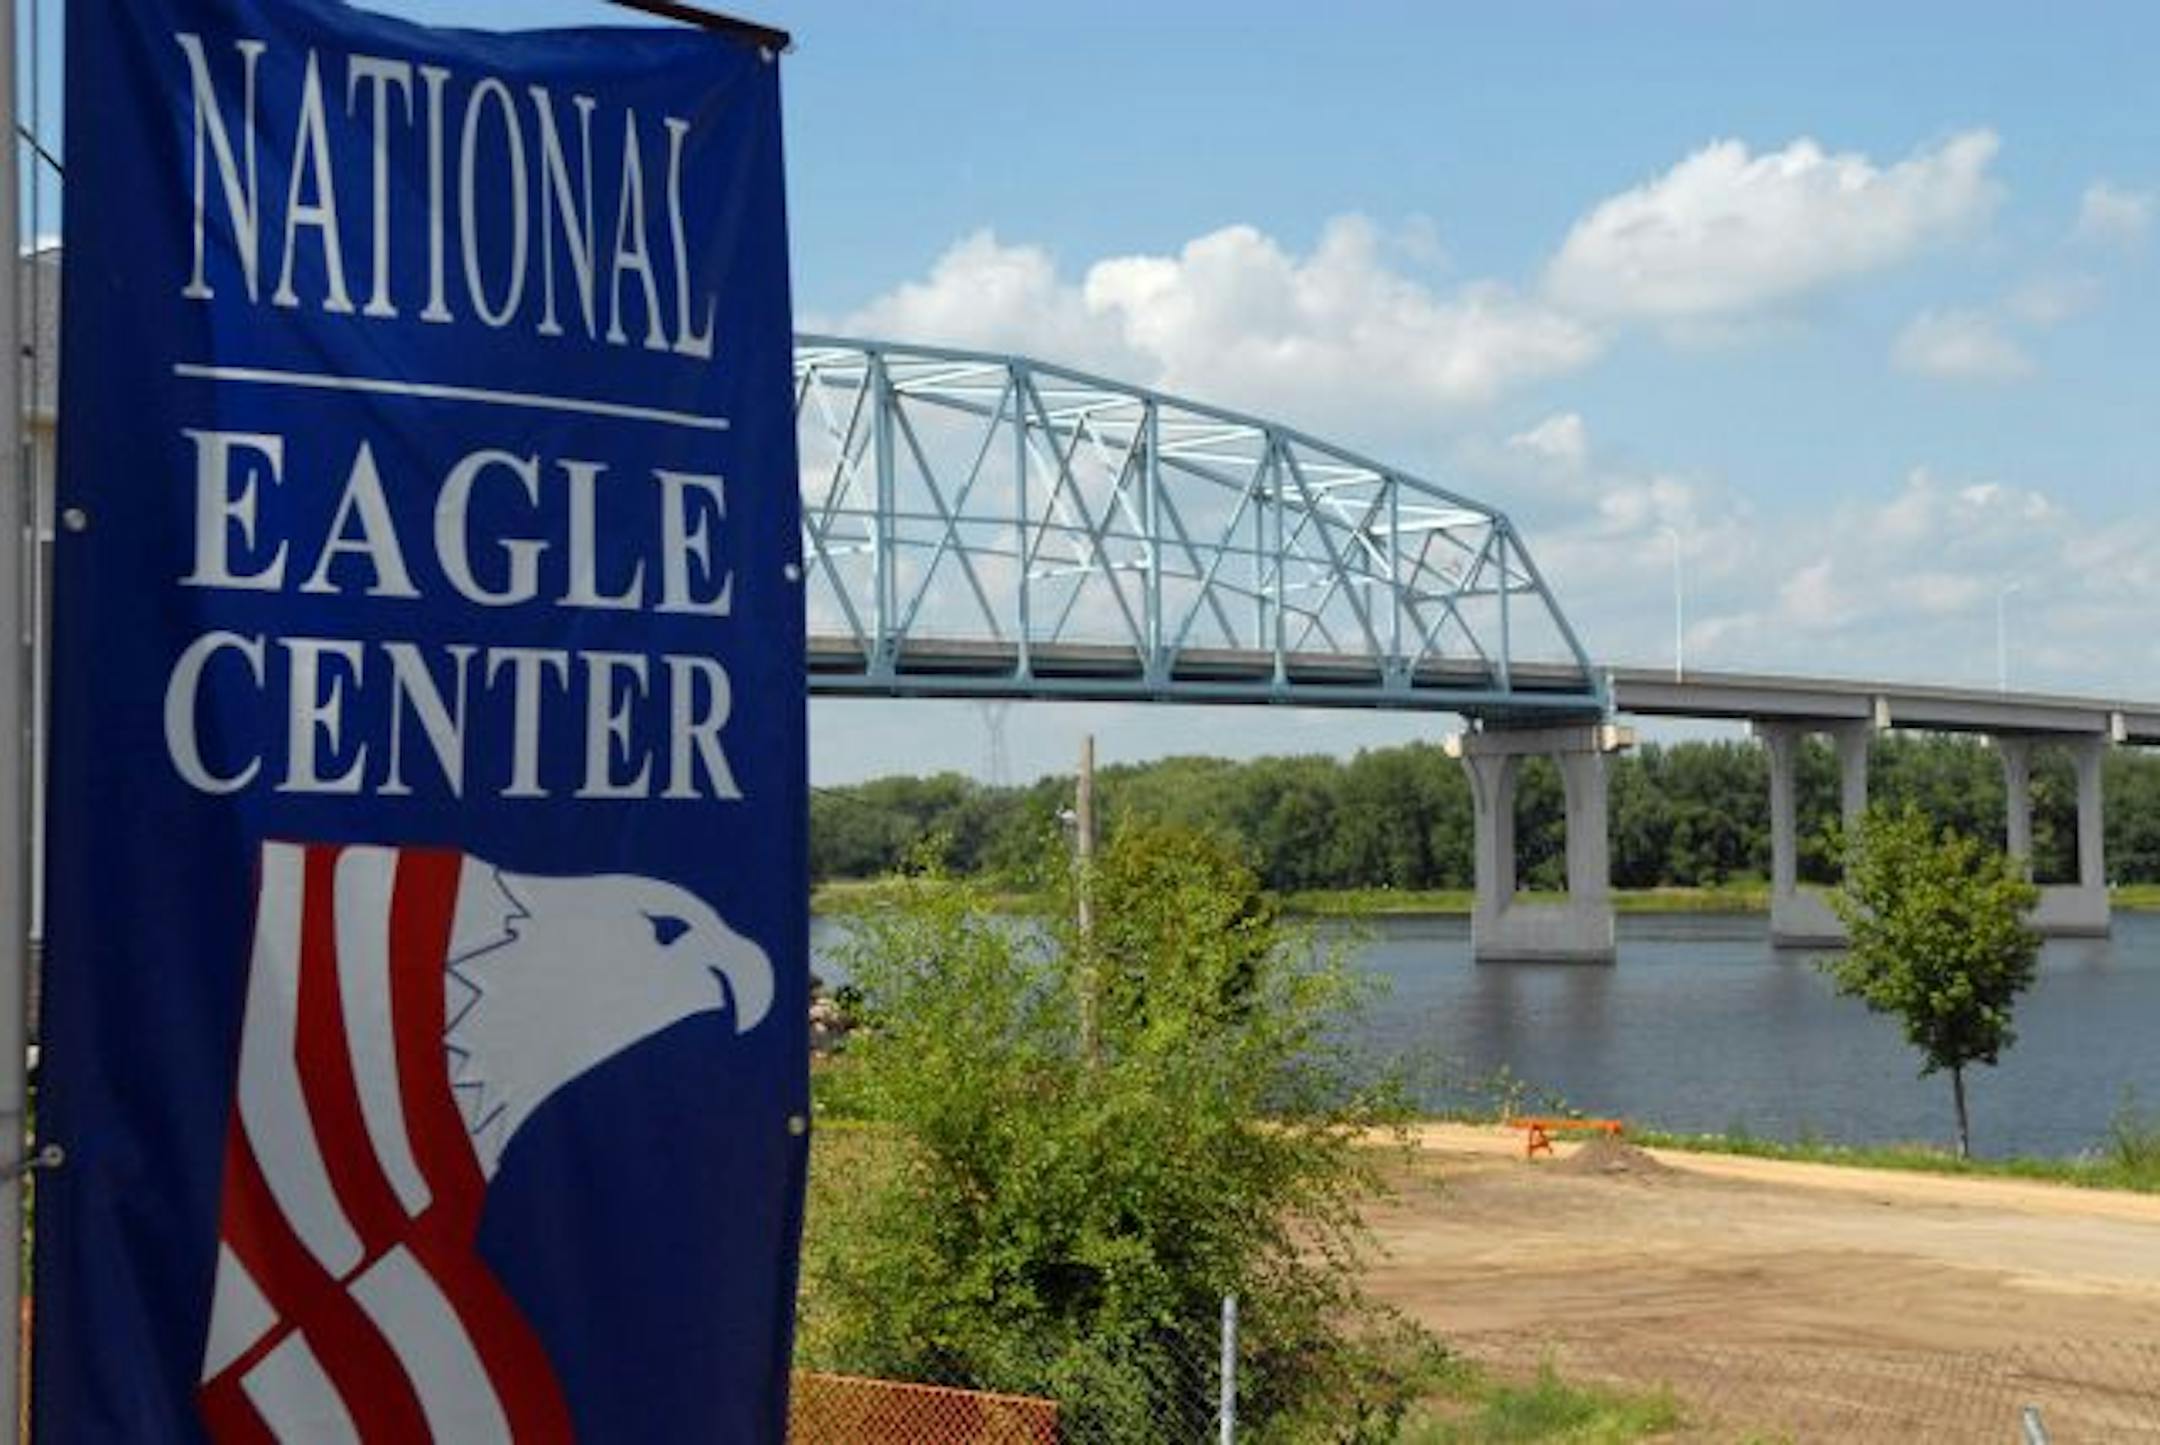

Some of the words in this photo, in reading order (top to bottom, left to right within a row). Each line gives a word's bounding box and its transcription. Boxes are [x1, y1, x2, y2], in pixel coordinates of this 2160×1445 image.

[175, 32, 715, 359] NATIONAL
[178, 428, 734, 616] EAGLE
[163, 630, 743, 800] CENTER
